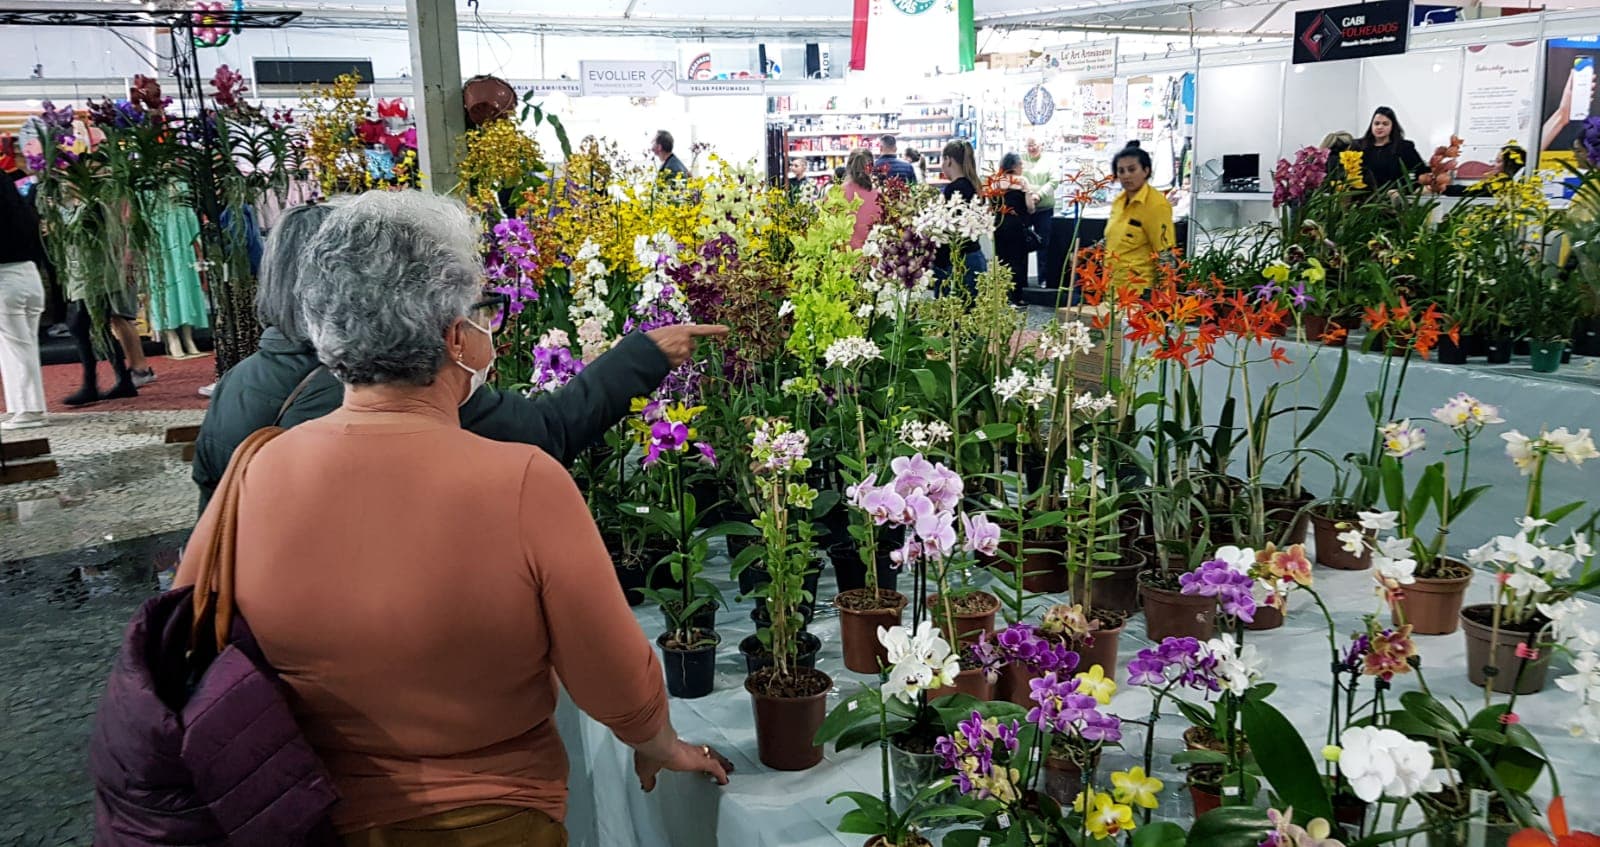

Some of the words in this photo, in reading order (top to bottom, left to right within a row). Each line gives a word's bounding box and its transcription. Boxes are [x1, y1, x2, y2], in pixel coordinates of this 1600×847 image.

[1342, 15, 1366, 27] GABI
[1342, 23, 1398, 37] FOLHEADOS
[589, 70, 646, 81] EVOLLIER
